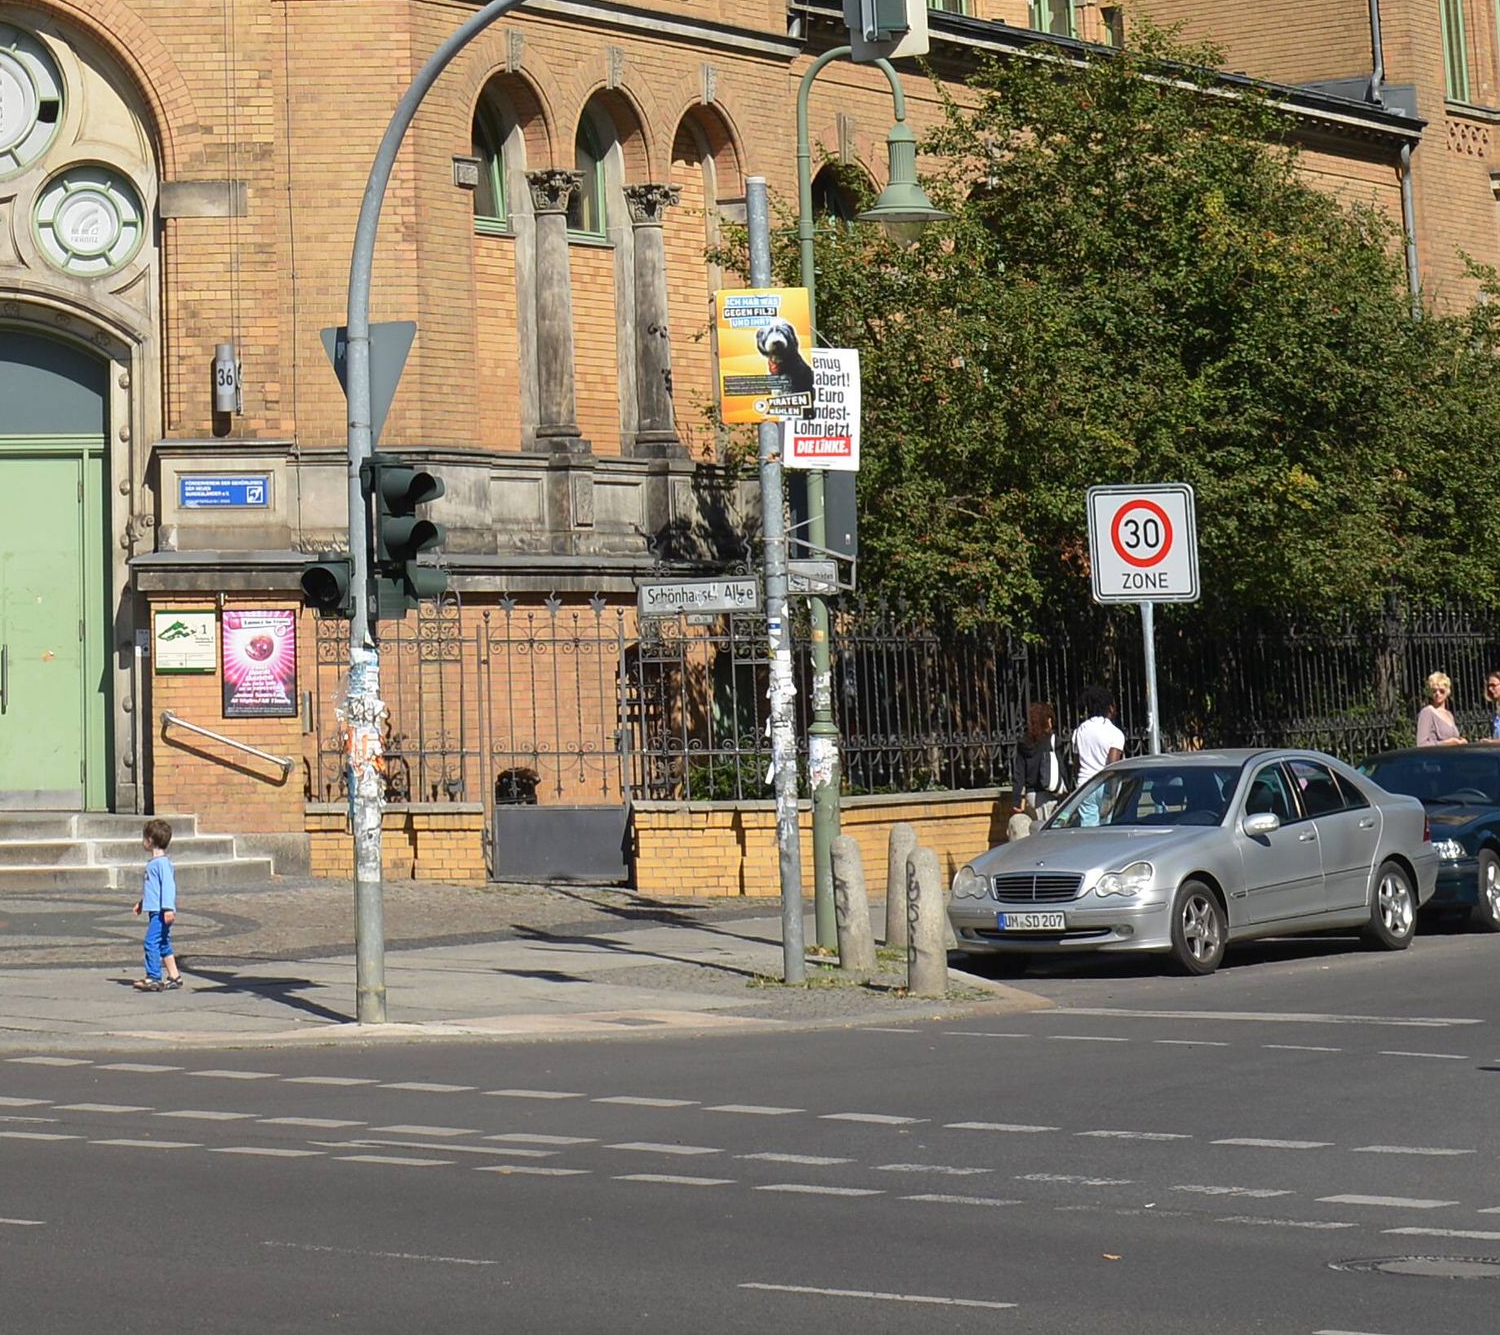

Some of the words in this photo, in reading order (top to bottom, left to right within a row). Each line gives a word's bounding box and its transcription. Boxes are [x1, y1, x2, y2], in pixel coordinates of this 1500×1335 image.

[724, 308, 753, 318] GEGEN
[731, 318, 750, 327] UND
[812, 357, 841, 372] enug
[217, 367, 234, 387] 36
[815, 372, 851, 388] abert!
[767, 394, 808, 407] PIRATEN
[818, 388, 844, 404] Euro
[814, 408, 851, 421] ndest-
[793, 420, 822, 435] Lohn
[822, 421, 853, 438] jetzt.
[796, 440, 814, 454] DIE
[1123, 518, 1160, 549] 30
[1121, 572, 1169, 590] ZONE
[724, 583, 755, 601] Alle
[1004, 914, 1019, 928] UM
[1024, 914, 1040, 928] SD
[1042, 914, 1063, 928] 207
